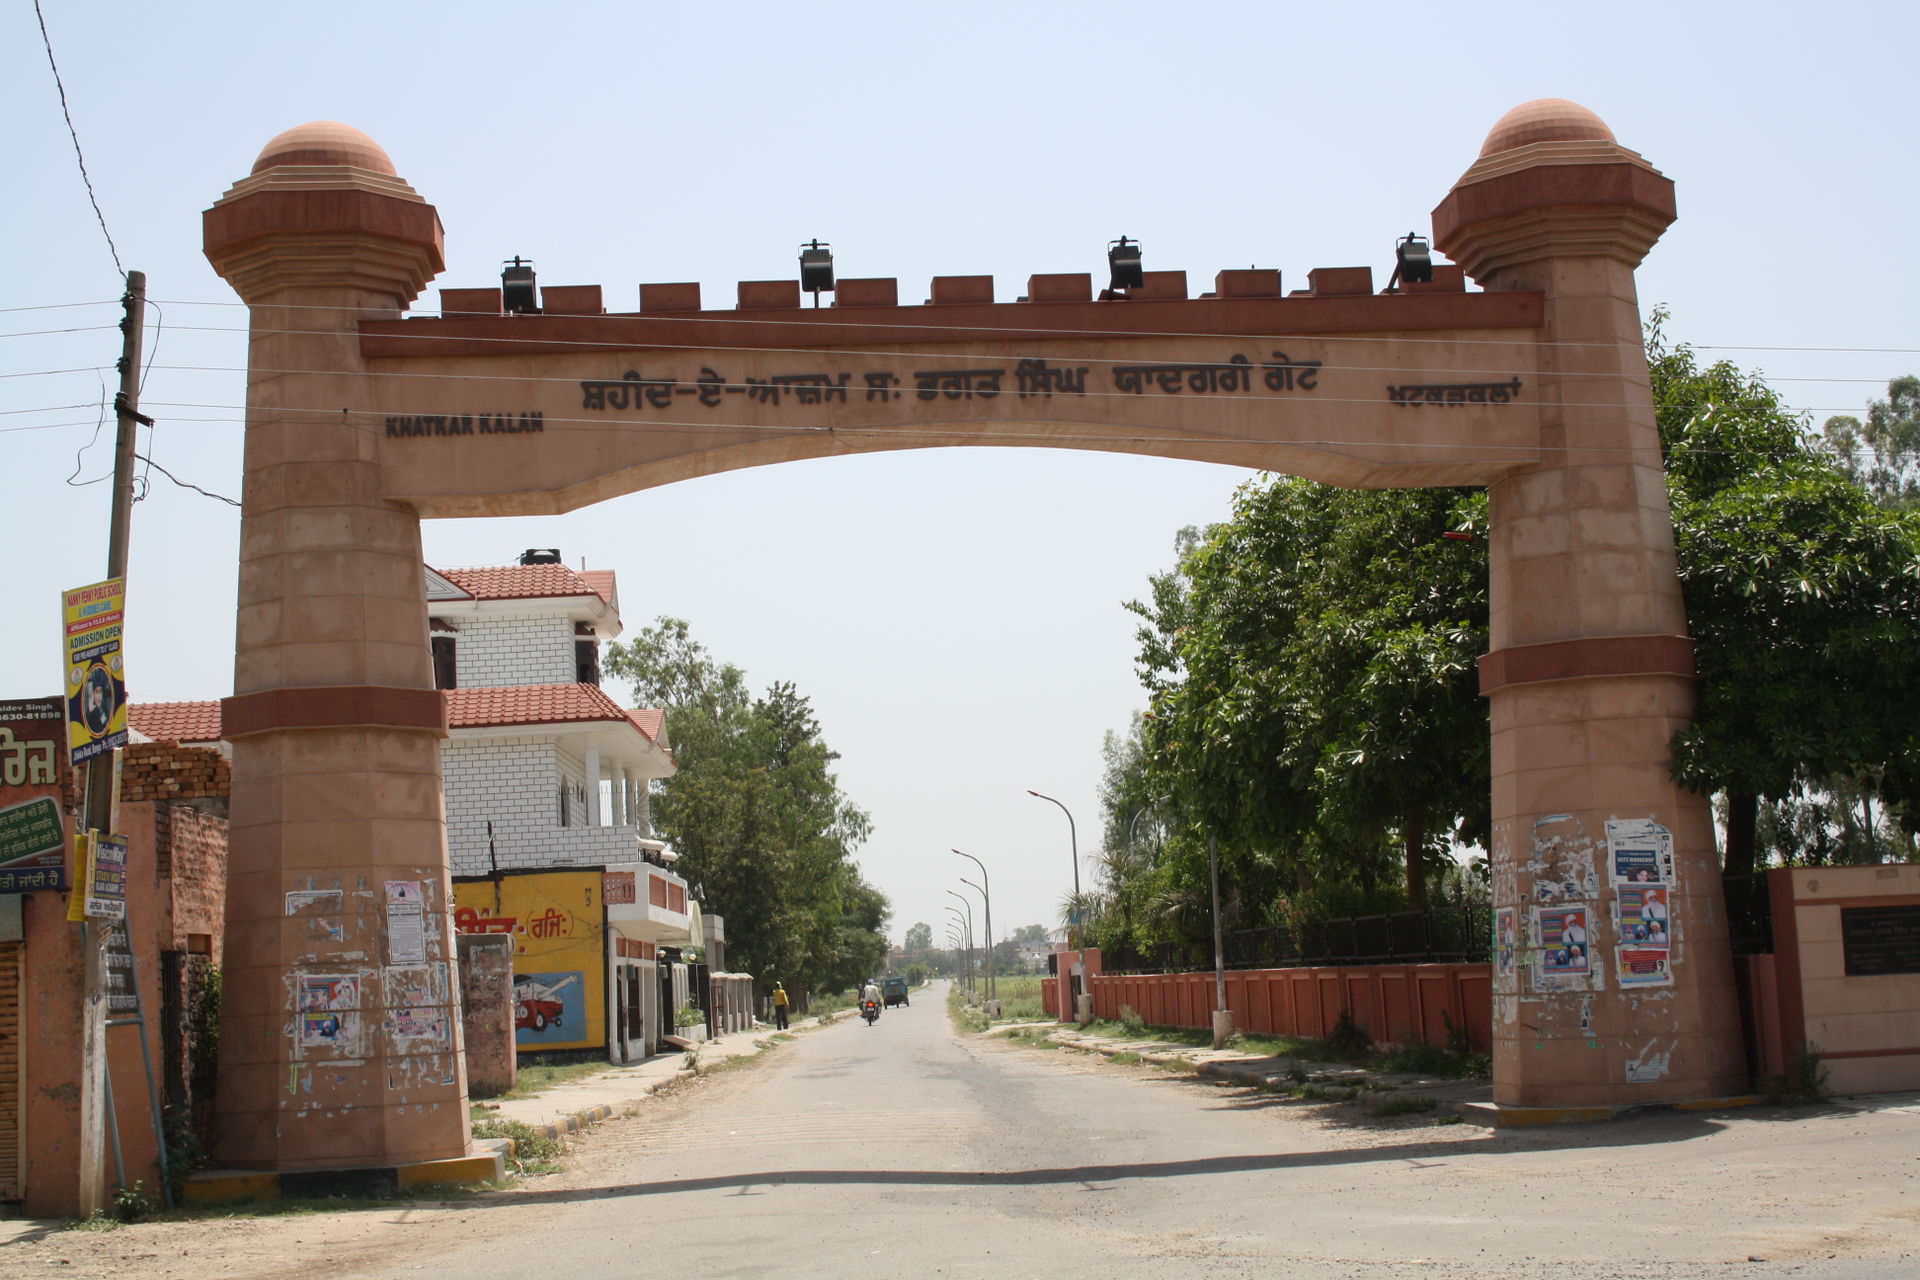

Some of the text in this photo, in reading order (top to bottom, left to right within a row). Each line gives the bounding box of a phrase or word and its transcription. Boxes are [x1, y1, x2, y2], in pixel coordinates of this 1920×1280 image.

[914, 369, 1005, 401] ਭਗਤ
[1014, 359, 1089, 399] ਸਿੰਘ
[1262, 351, 1322, 391] ਗੇਟ
[385, 411, 543, 438] KHATKAR KALAN
[108, 584, 121, 596] SCHOOL
[71, 626, 121, 648] ADMISSION OPEN
[25, 703, 53, 712] Singh
